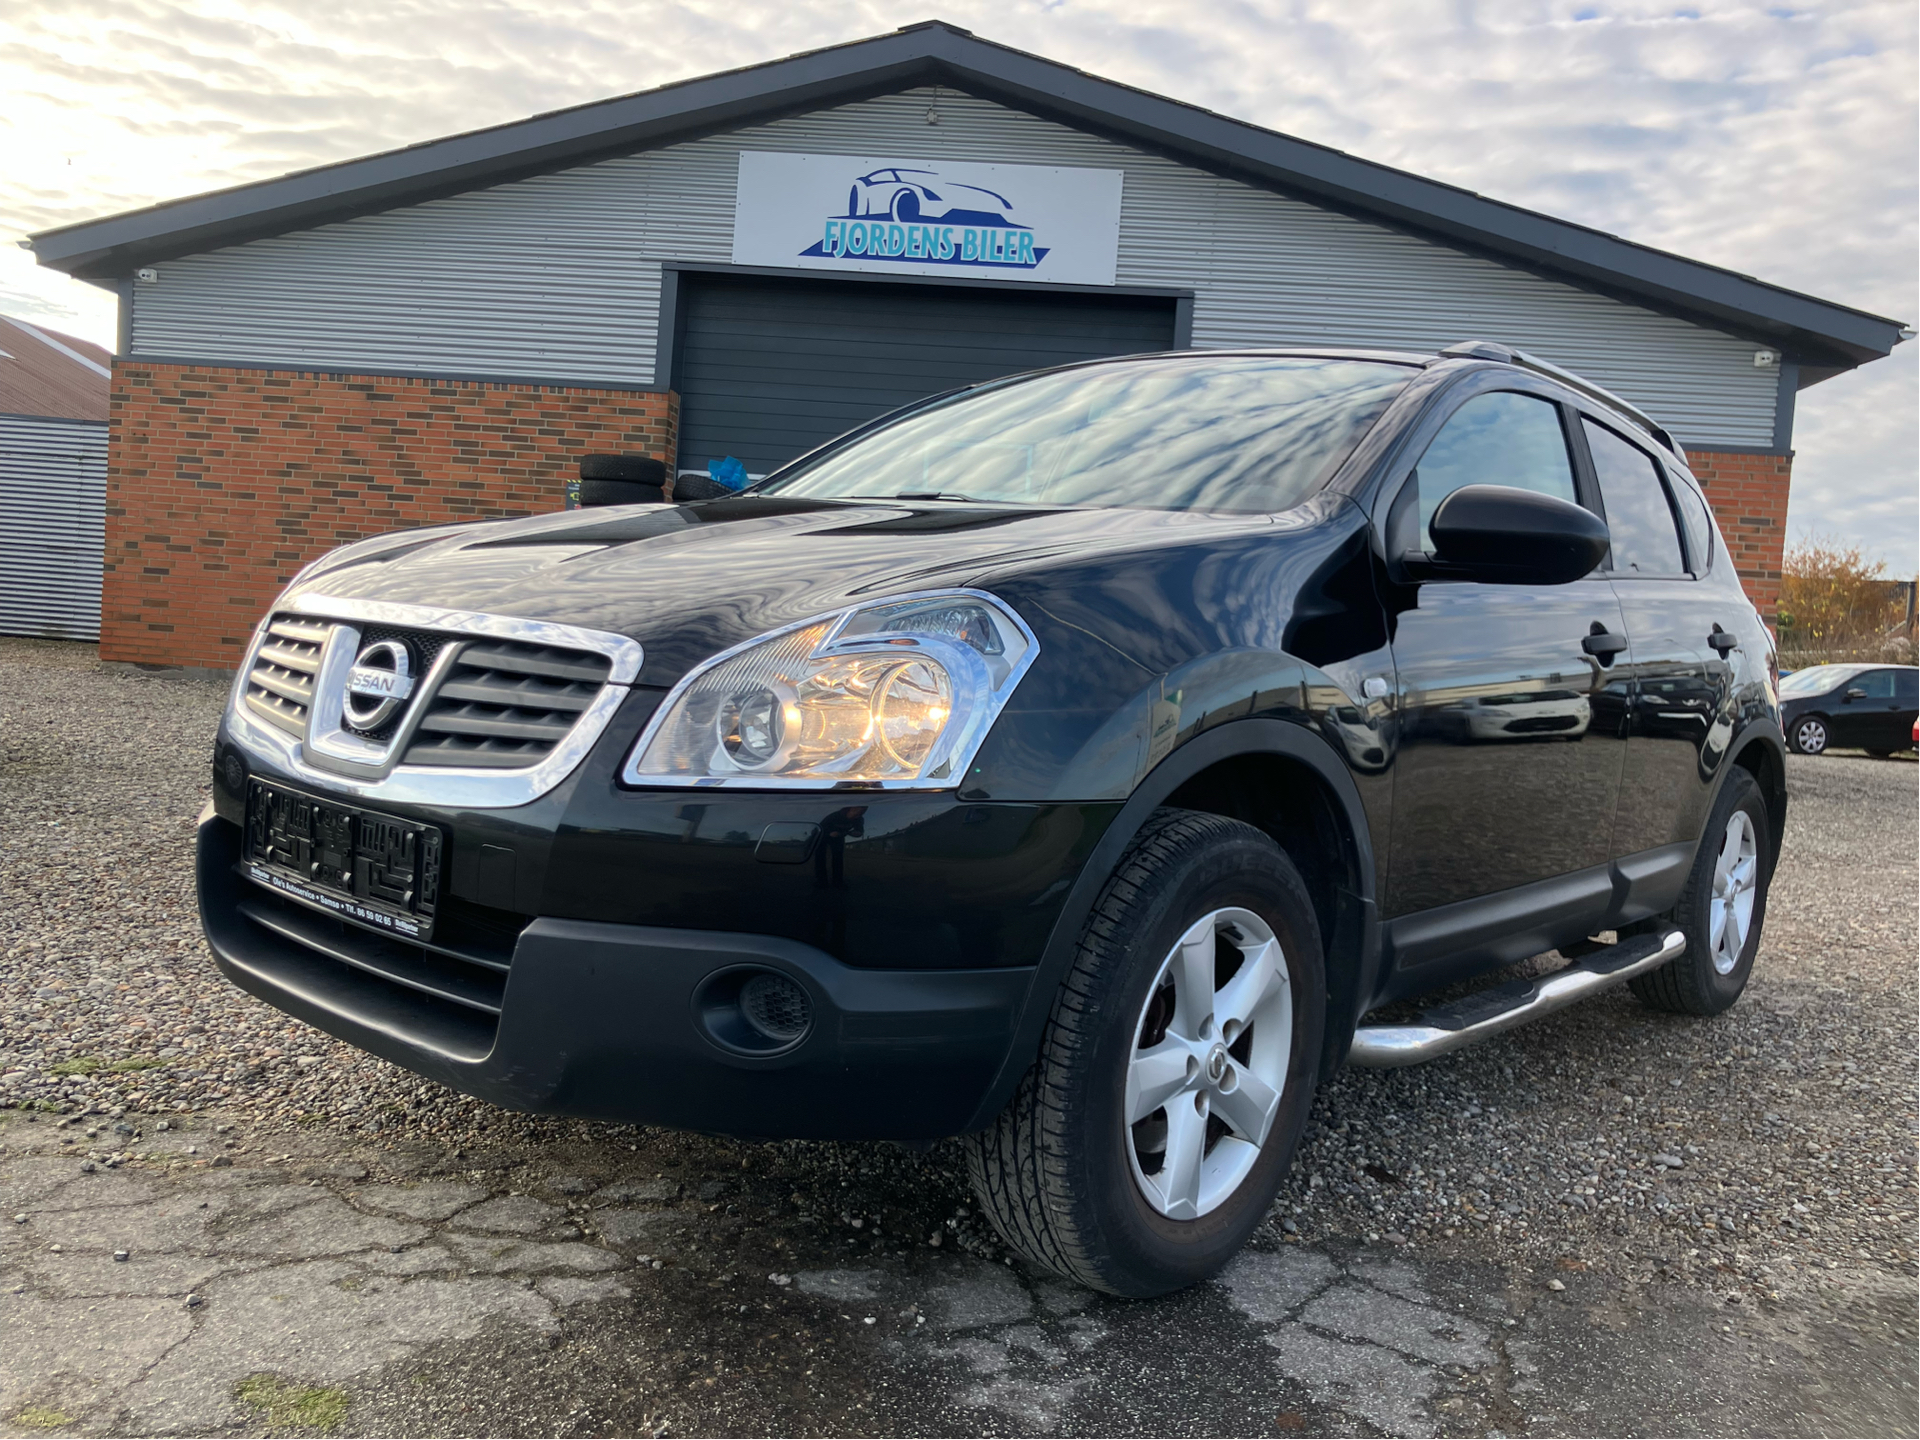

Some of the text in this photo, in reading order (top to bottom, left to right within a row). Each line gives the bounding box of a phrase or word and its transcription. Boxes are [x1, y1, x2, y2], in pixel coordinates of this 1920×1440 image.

[822, 221, 1037, 265] FJORDENS BILER
[285, 882, 315, 900] Autoservice
[374, 913, 383, 923] 02
